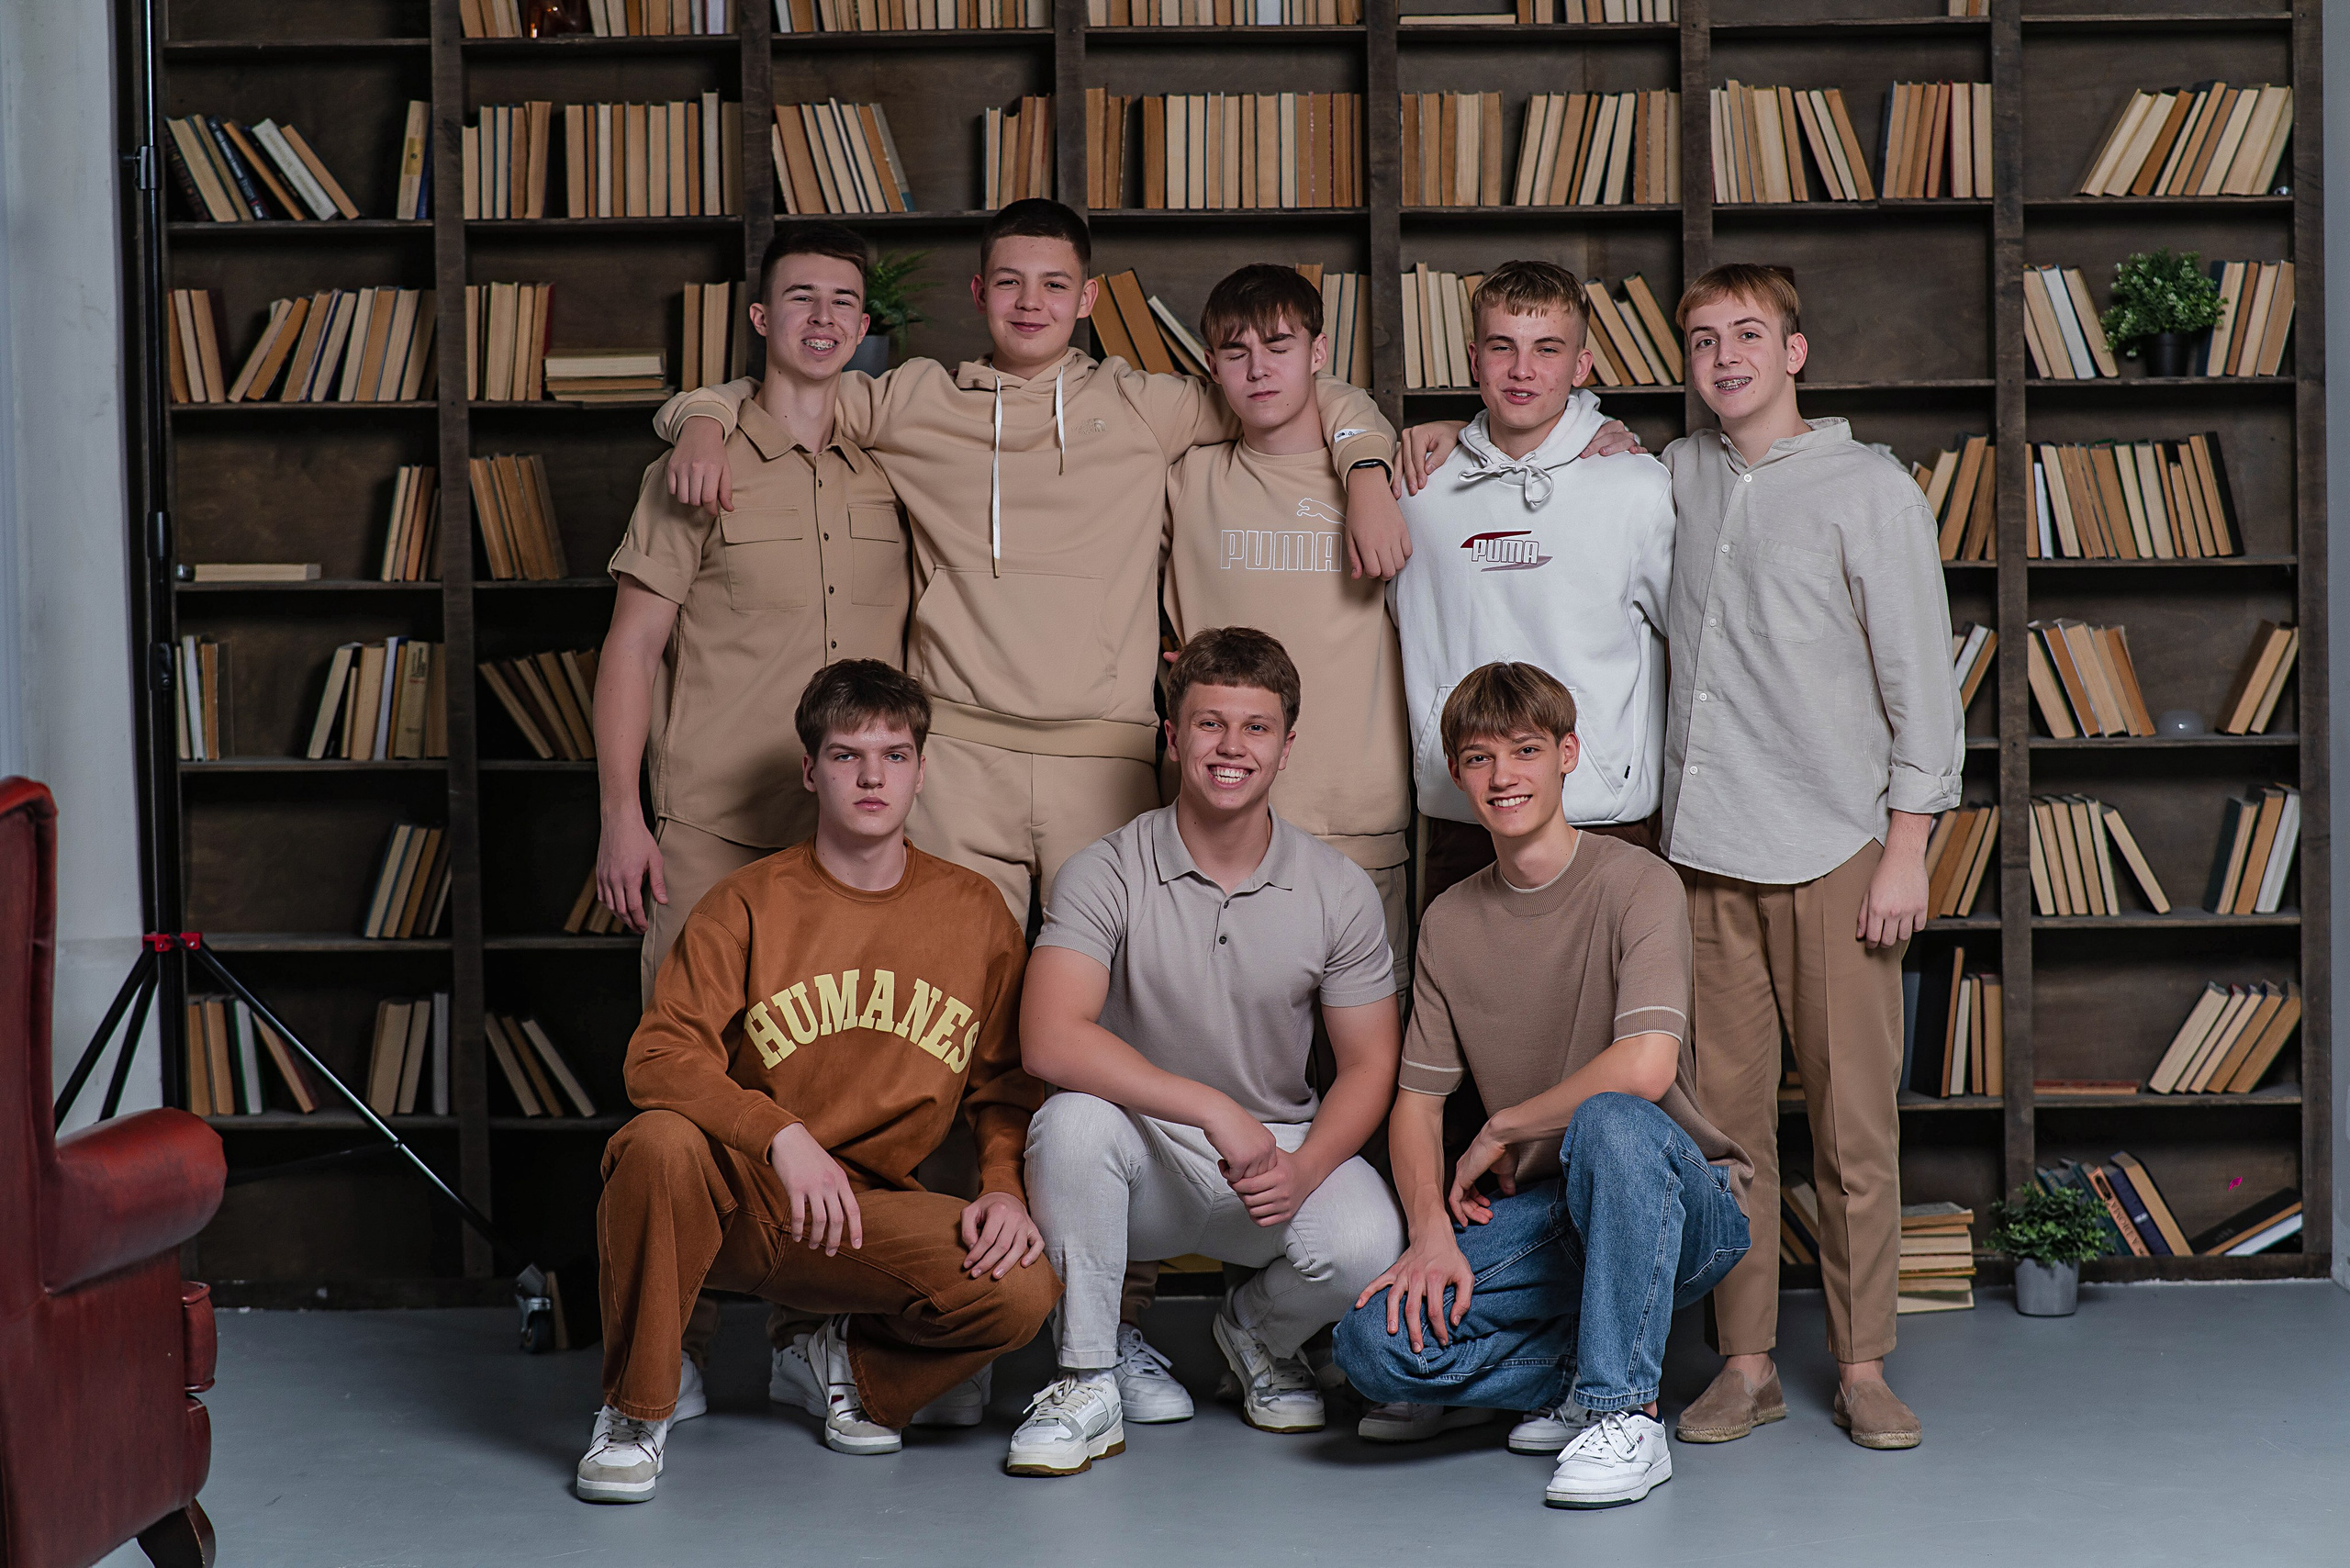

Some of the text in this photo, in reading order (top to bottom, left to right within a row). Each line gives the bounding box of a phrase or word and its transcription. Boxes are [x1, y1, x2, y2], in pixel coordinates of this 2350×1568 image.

[1220, 530, 1343, 572] PUMA
[1471, 539, 1539, 565] PUMA
[744, 969, 980, 1074] HUMANES
